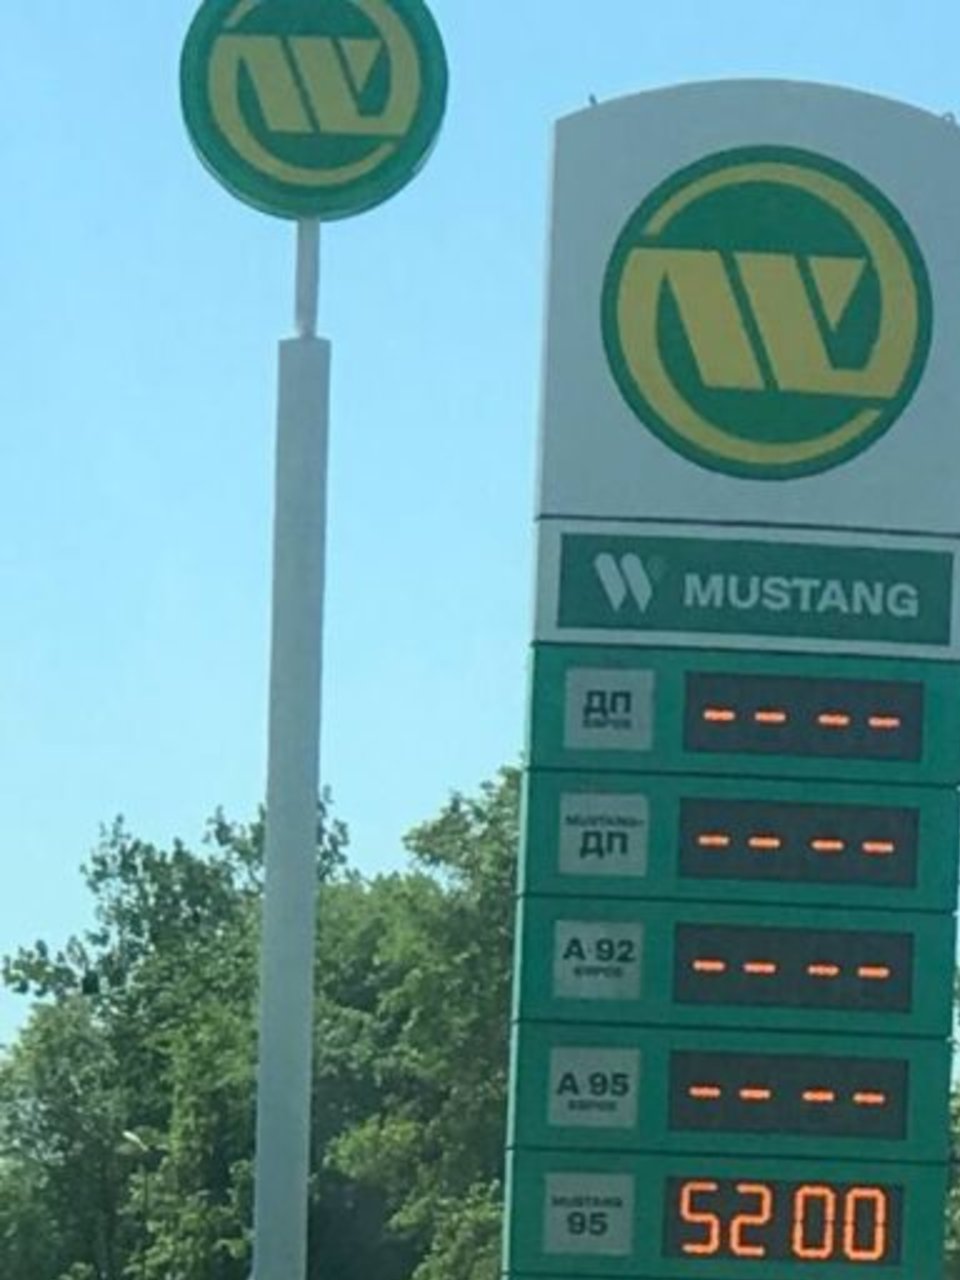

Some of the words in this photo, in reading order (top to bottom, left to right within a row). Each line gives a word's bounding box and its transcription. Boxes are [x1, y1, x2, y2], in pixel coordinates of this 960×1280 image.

[684, 572, 919, 618] MUSTANG
[582, 689, 632, 718] ДП
[579, 830, 629, 859] ДП
[595, 938, 637, 963] 92
[587, 1072, 630, 1097] 95
[566, 1211, 609, 1237] 95
